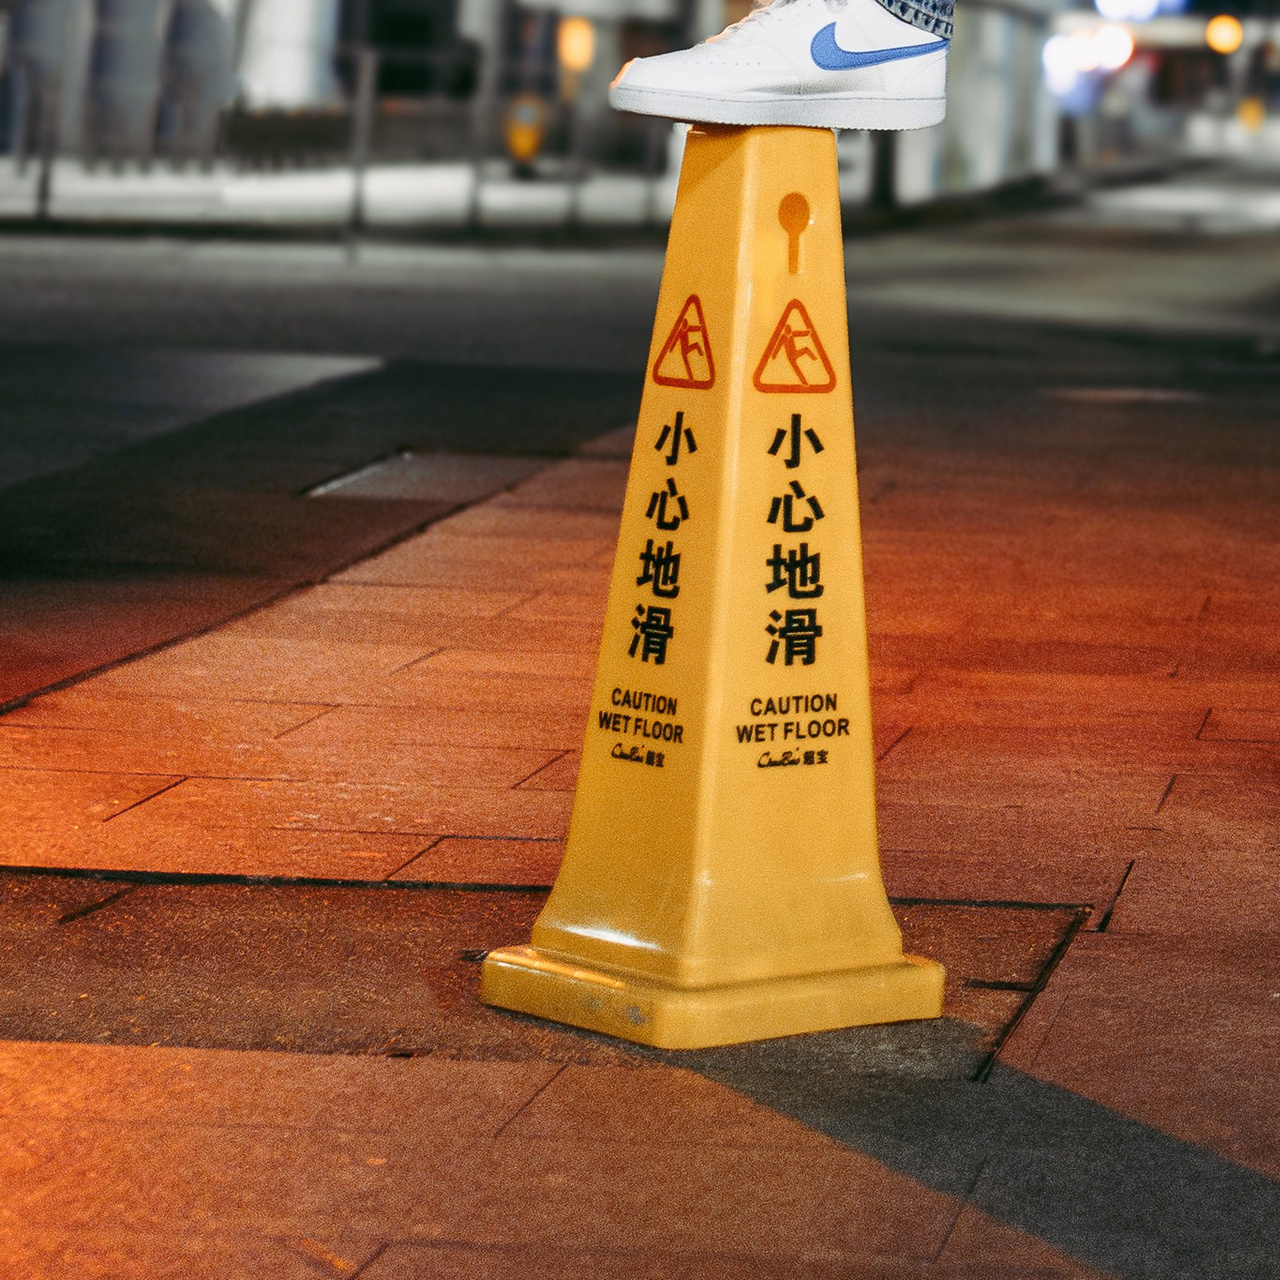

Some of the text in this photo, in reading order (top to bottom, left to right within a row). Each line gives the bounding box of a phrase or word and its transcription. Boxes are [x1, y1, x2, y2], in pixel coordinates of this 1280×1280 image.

[628, 410, 698, 666] 小心地滑
[765, 413, 825, 666] 小心地滑
[611, 687, 677, 716] CAUTION
[751, 693, 837, 716] CAUTION
[599, 710, 684, 744] WET FLOOR
[736, 718, 850, 743] WET FLOOR
